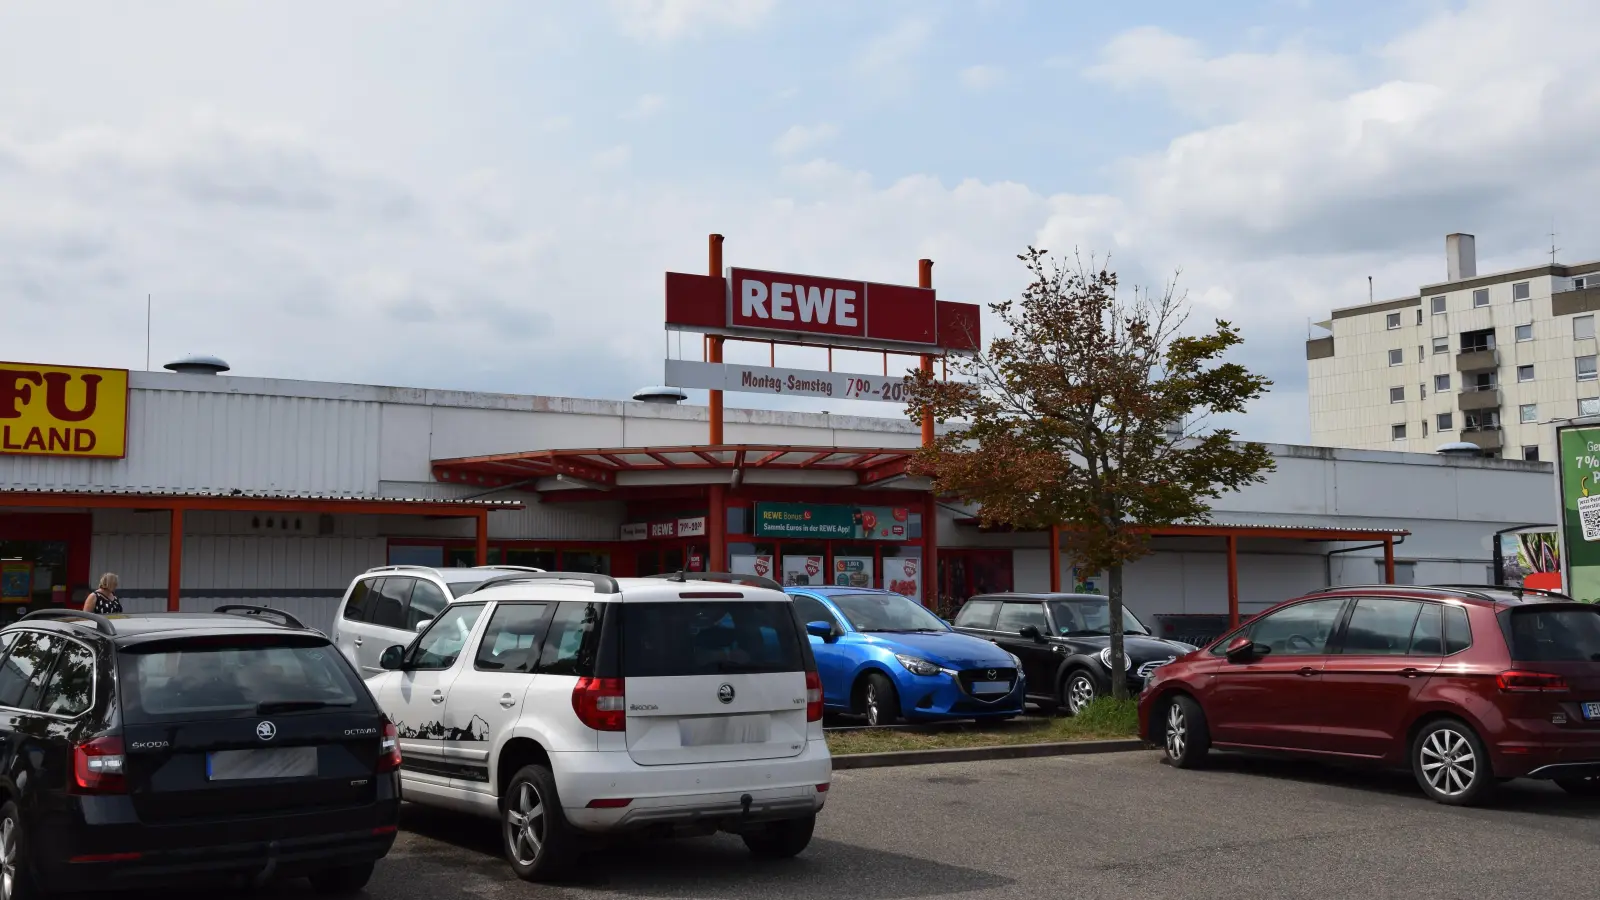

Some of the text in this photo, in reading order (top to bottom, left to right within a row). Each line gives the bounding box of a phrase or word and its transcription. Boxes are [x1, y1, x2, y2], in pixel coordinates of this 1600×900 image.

[741, 279, 858, 327] REWE
[3, 425, 97, 452] LAND
[763, 511, 803, 520] REWE Bonus
[652, 523, 674, 536] REWE
[763, 523, 785, 531] Sammle
[786, 523, 802, 532] Euros
[809, 524, 818, 532] der
[819, 524, 836, 532] REWE
[837, 525, 850, 534] App!
[344, 728, 377, 736] OCTAVIA
